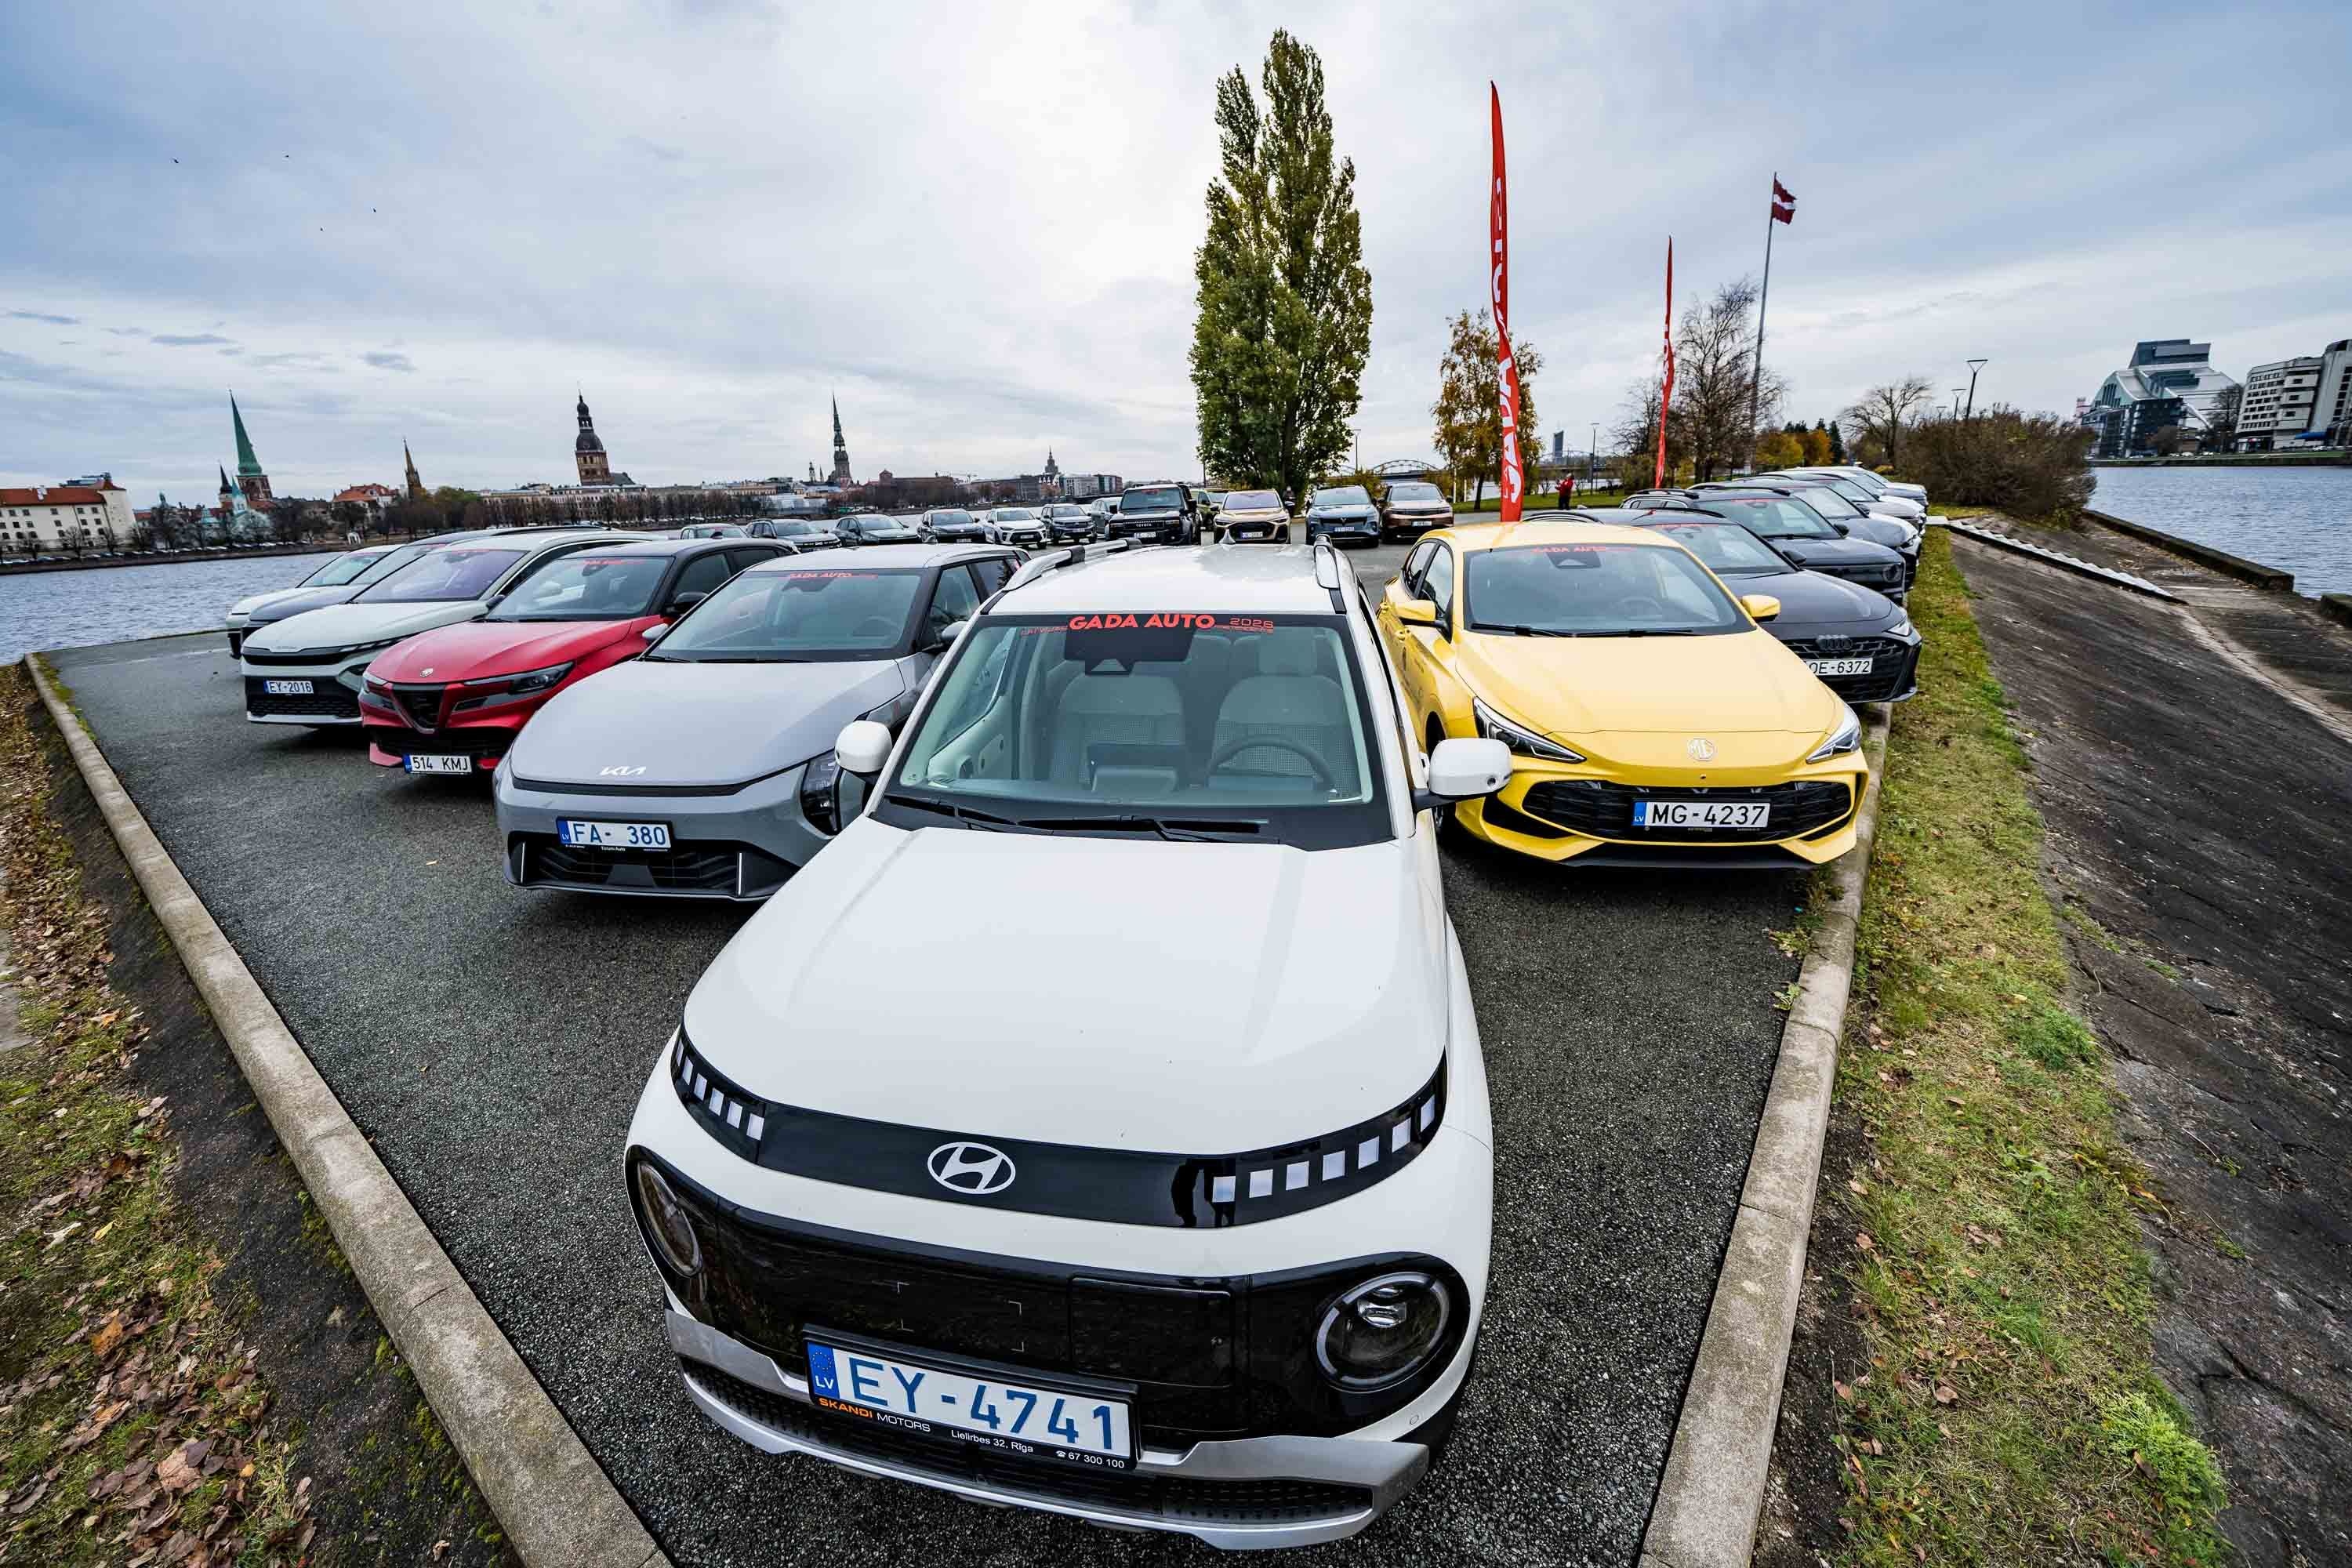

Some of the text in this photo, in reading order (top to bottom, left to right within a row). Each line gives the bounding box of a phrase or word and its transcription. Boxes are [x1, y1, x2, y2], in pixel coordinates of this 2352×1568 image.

[1069, 614, 1138, 630] GADA
[1144, 614, 1215, 629] AUTO
[1229, 618, 1274, 629] 2026
[270, 681, 312, 692] EY-2016
[412, 757, 468, 770] 514 KMJ
[598, 766, 647, 776] KIA
[1652, 804, 1766, 826] MG-4237
[815, 1357, 1112, 1450] LV EY-4741
[818, 1397, 931, 1432] SKANDI MOTORS
[951, 1429, 991, 1445] Lielirbes
[1011, 1441, 1033, 1454] Rīga
[1068, 1451, 1124, 1468] 67 300 100
